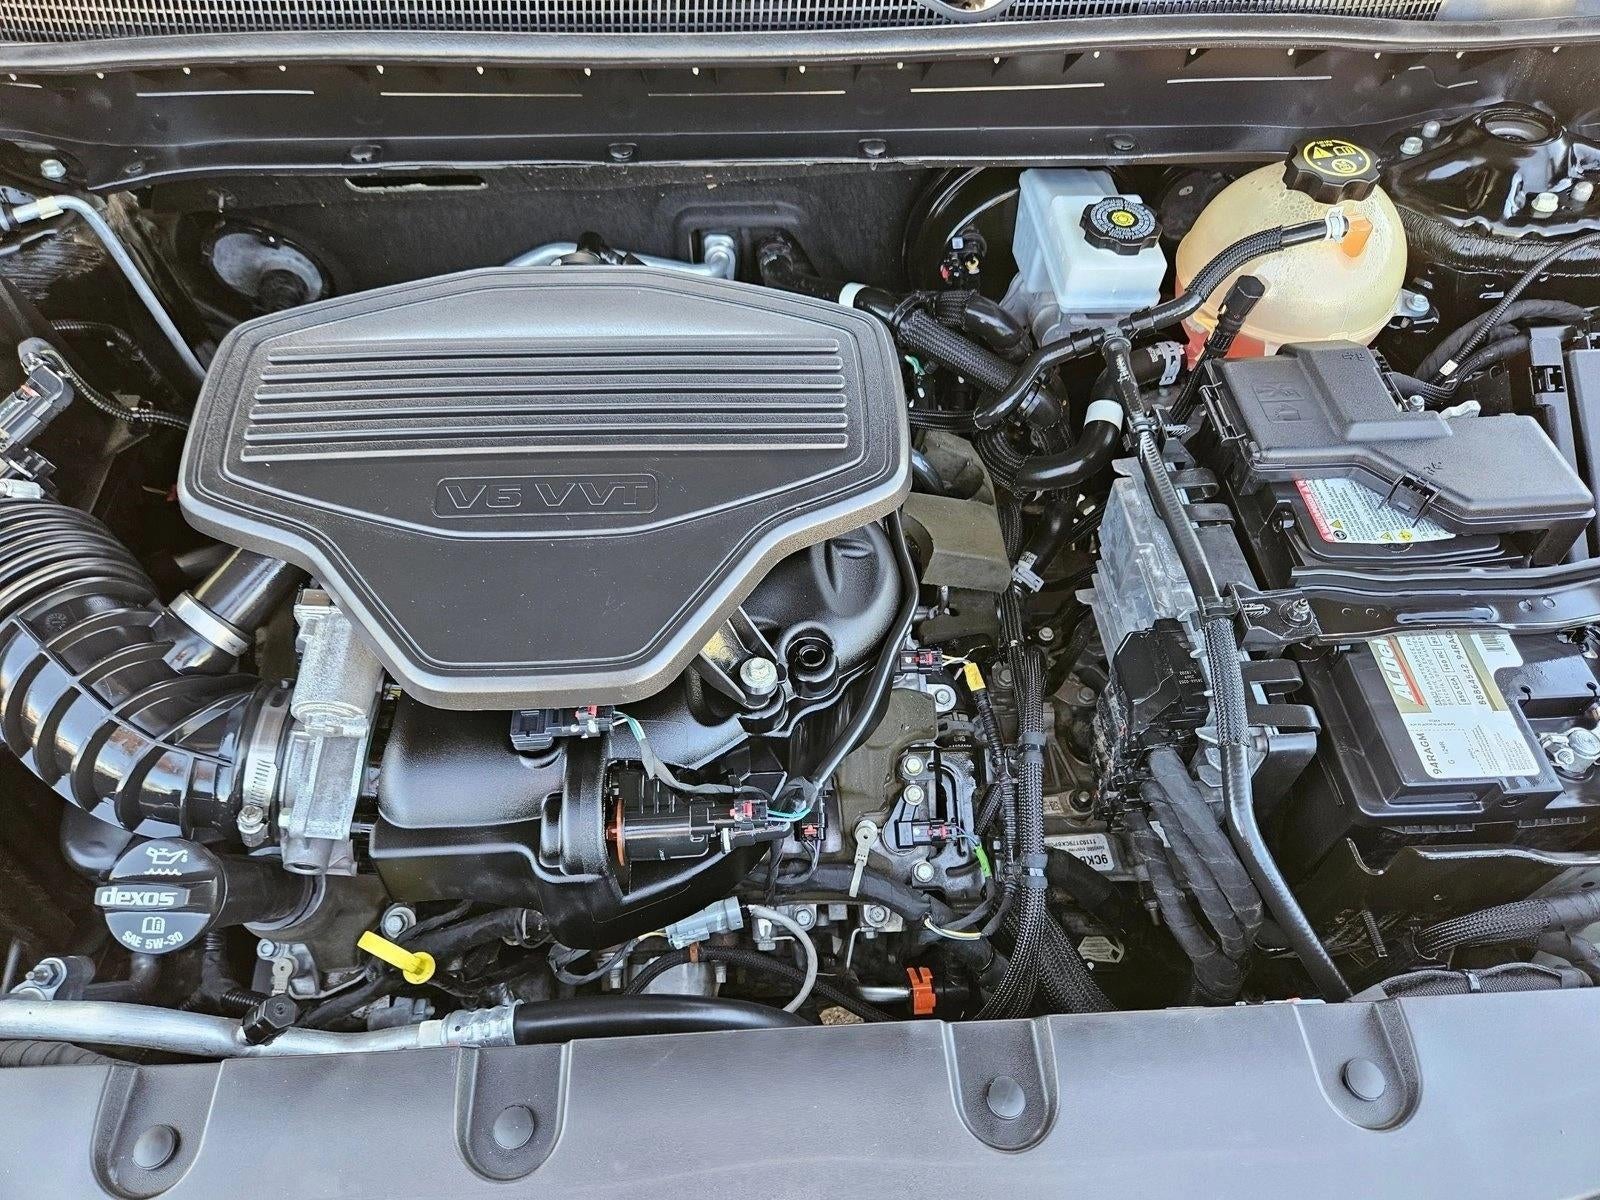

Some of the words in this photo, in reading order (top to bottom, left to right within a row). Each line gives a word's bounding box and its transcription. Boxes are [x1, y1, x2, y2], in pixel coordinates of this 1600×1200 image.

[445, 484, 521, 509] V6
[534, 482, 648, 506] VVT
[1447, 631, 1464, 659] 94RAG
[1371, 638, 1416, 703] ACDel
[1417, 733, 1442, 774] 94RAGM
[101, 886, 178, 906] dexos
[122, 930, 142, 948] SAE
[145, 931, 184, 949] 5W-30
